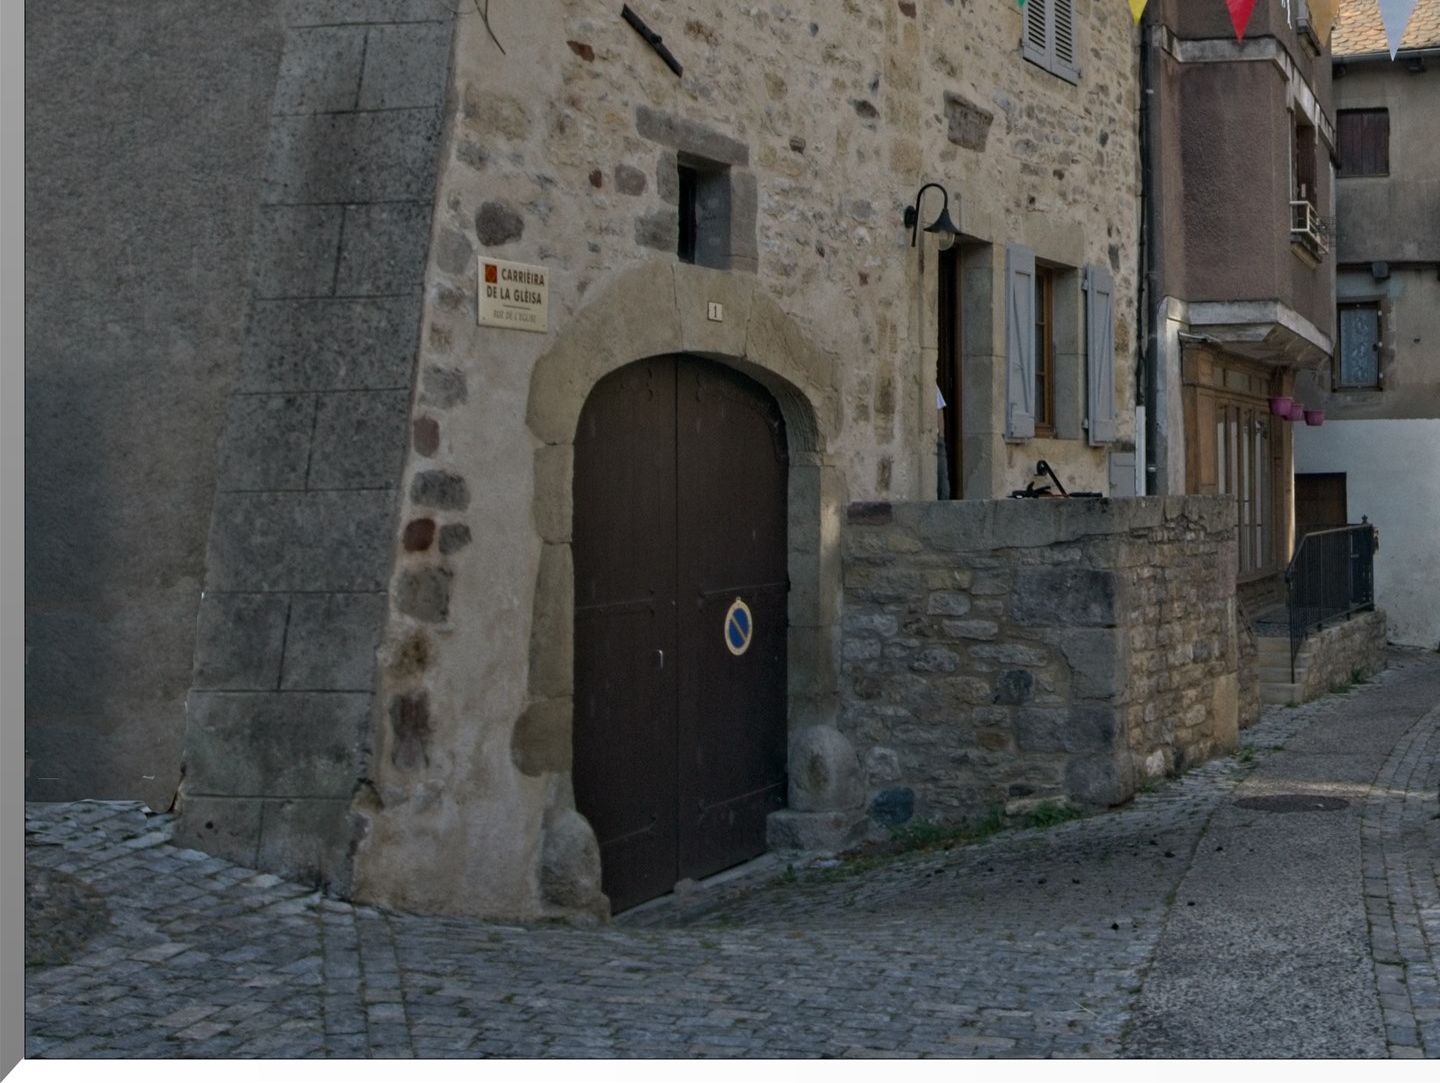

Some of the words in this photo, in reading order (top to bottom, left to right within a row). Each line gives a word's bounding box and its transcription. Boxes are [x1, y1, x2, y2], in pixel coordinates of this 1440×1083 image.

[486, 285, 497, 298] DE
[500, 287, 510, 300] LA
[505, 311, 513, 320] DE
